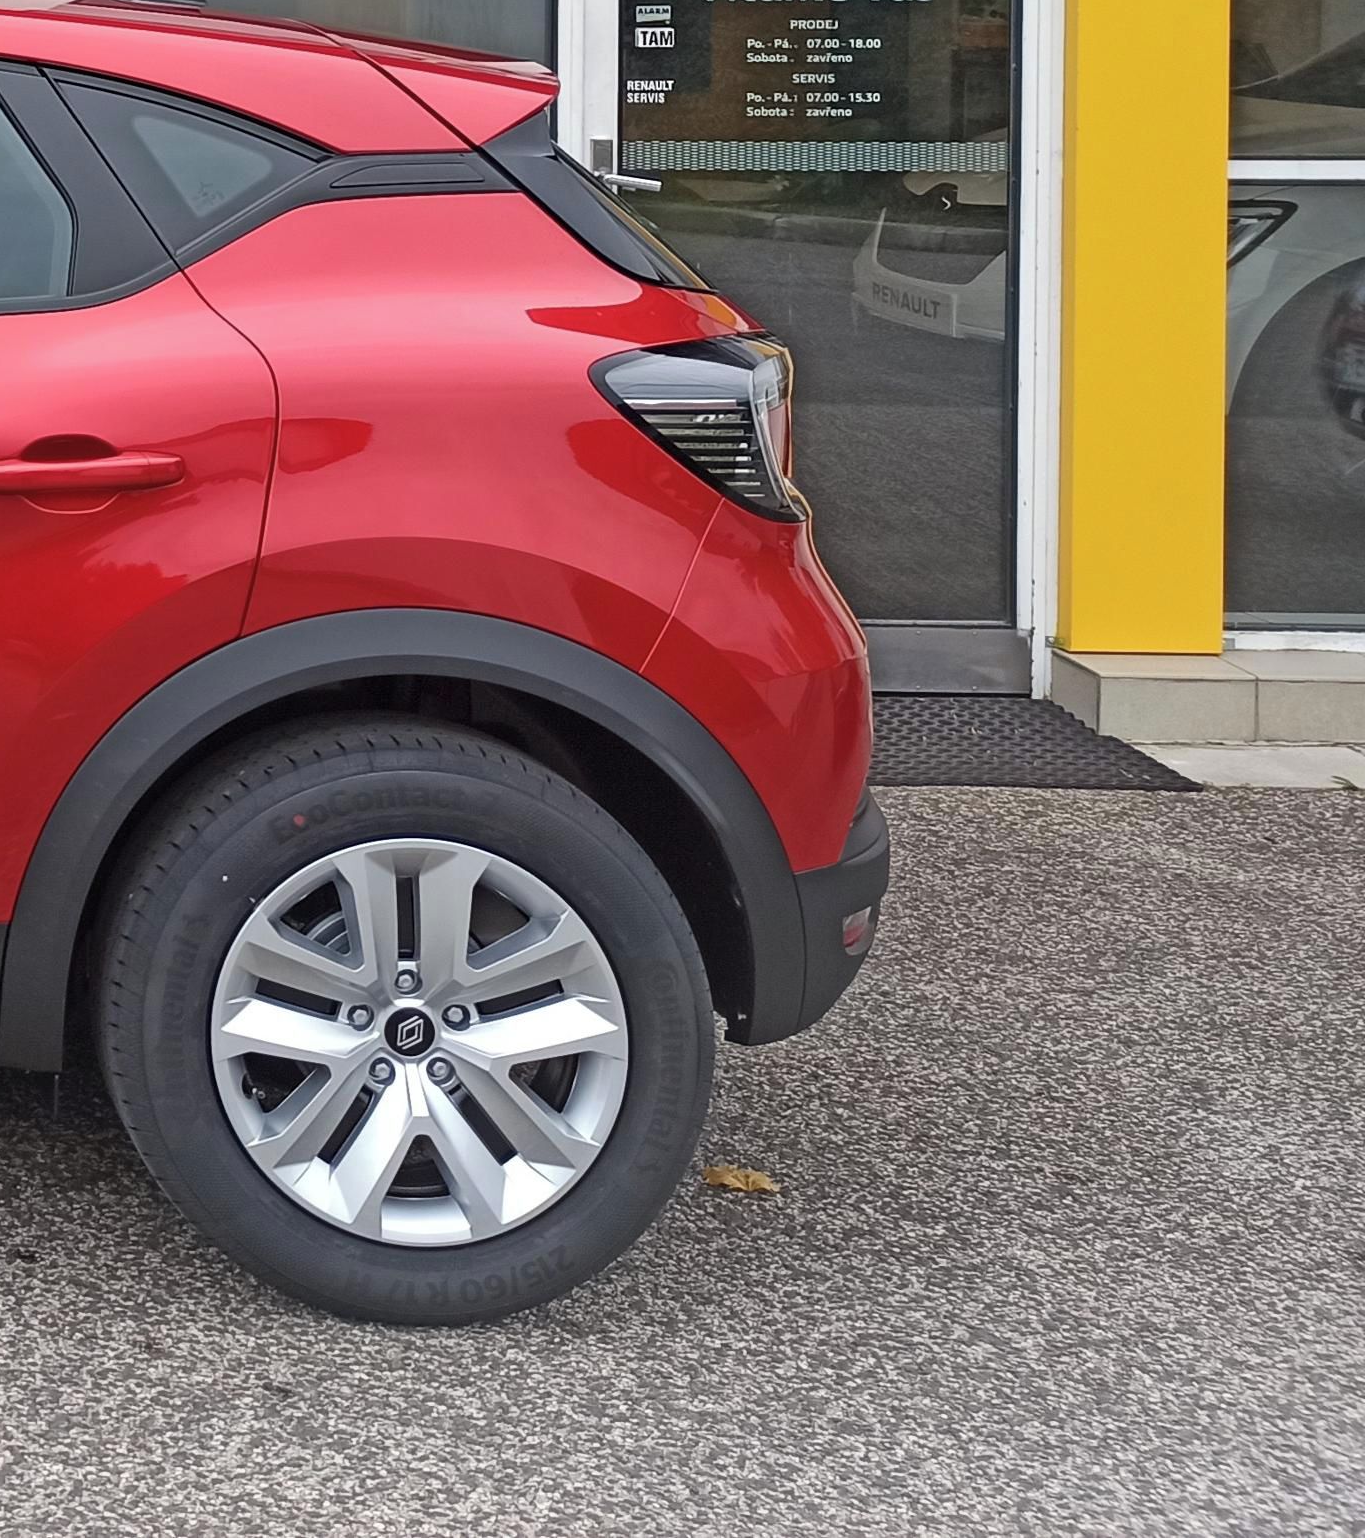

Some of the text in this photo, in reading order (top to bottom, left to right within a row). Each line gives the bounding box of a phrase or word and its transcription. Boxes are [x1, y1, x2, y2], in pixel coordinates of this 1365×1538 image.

[789, 19, 839, 30] PRODEJ
[640, 30, 673, 46] TAM
[806, 52, 853, 63] zavřeno
[792, 73, 836, 84] SERVIS
[626, 80, 674, 91] RENAULT
[626, 92, 665, 103] SERVIS
[806, 106, 853, 117] zavřeno
[872, 282, 940, 319] RENAULT
